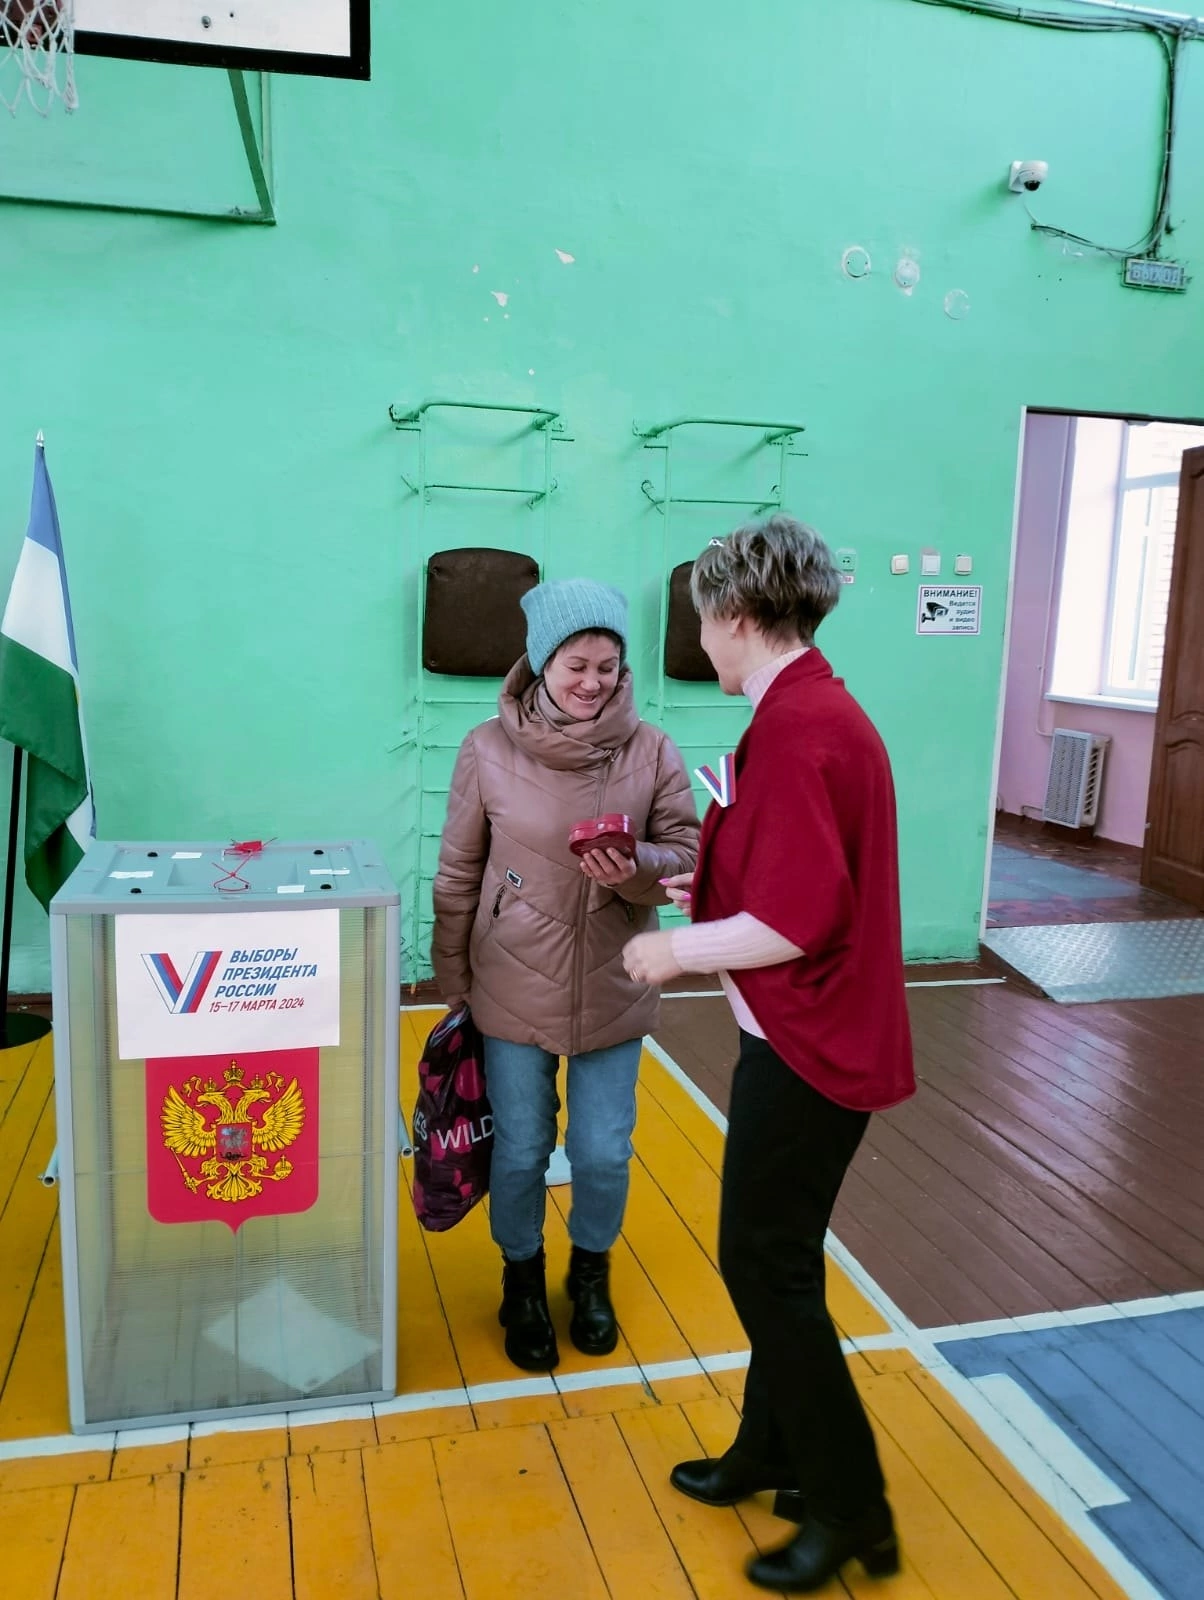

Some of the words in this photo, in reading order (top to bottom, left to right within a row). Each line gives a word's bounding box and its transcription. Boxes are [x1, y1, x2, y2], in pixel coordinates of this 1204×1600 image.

[923, 589, 978, 598] ВНИМАНИЕ!
[229, 948, 298, 963] ВЫБОРЫ
[222, 964, 318, 981] ПРЕЗИДЕНТА
[214, 983, 277, 998] РОССИИ
[240, 999, 277, 1012] МАРТА
[278, 997, 305, 1010] 2024
